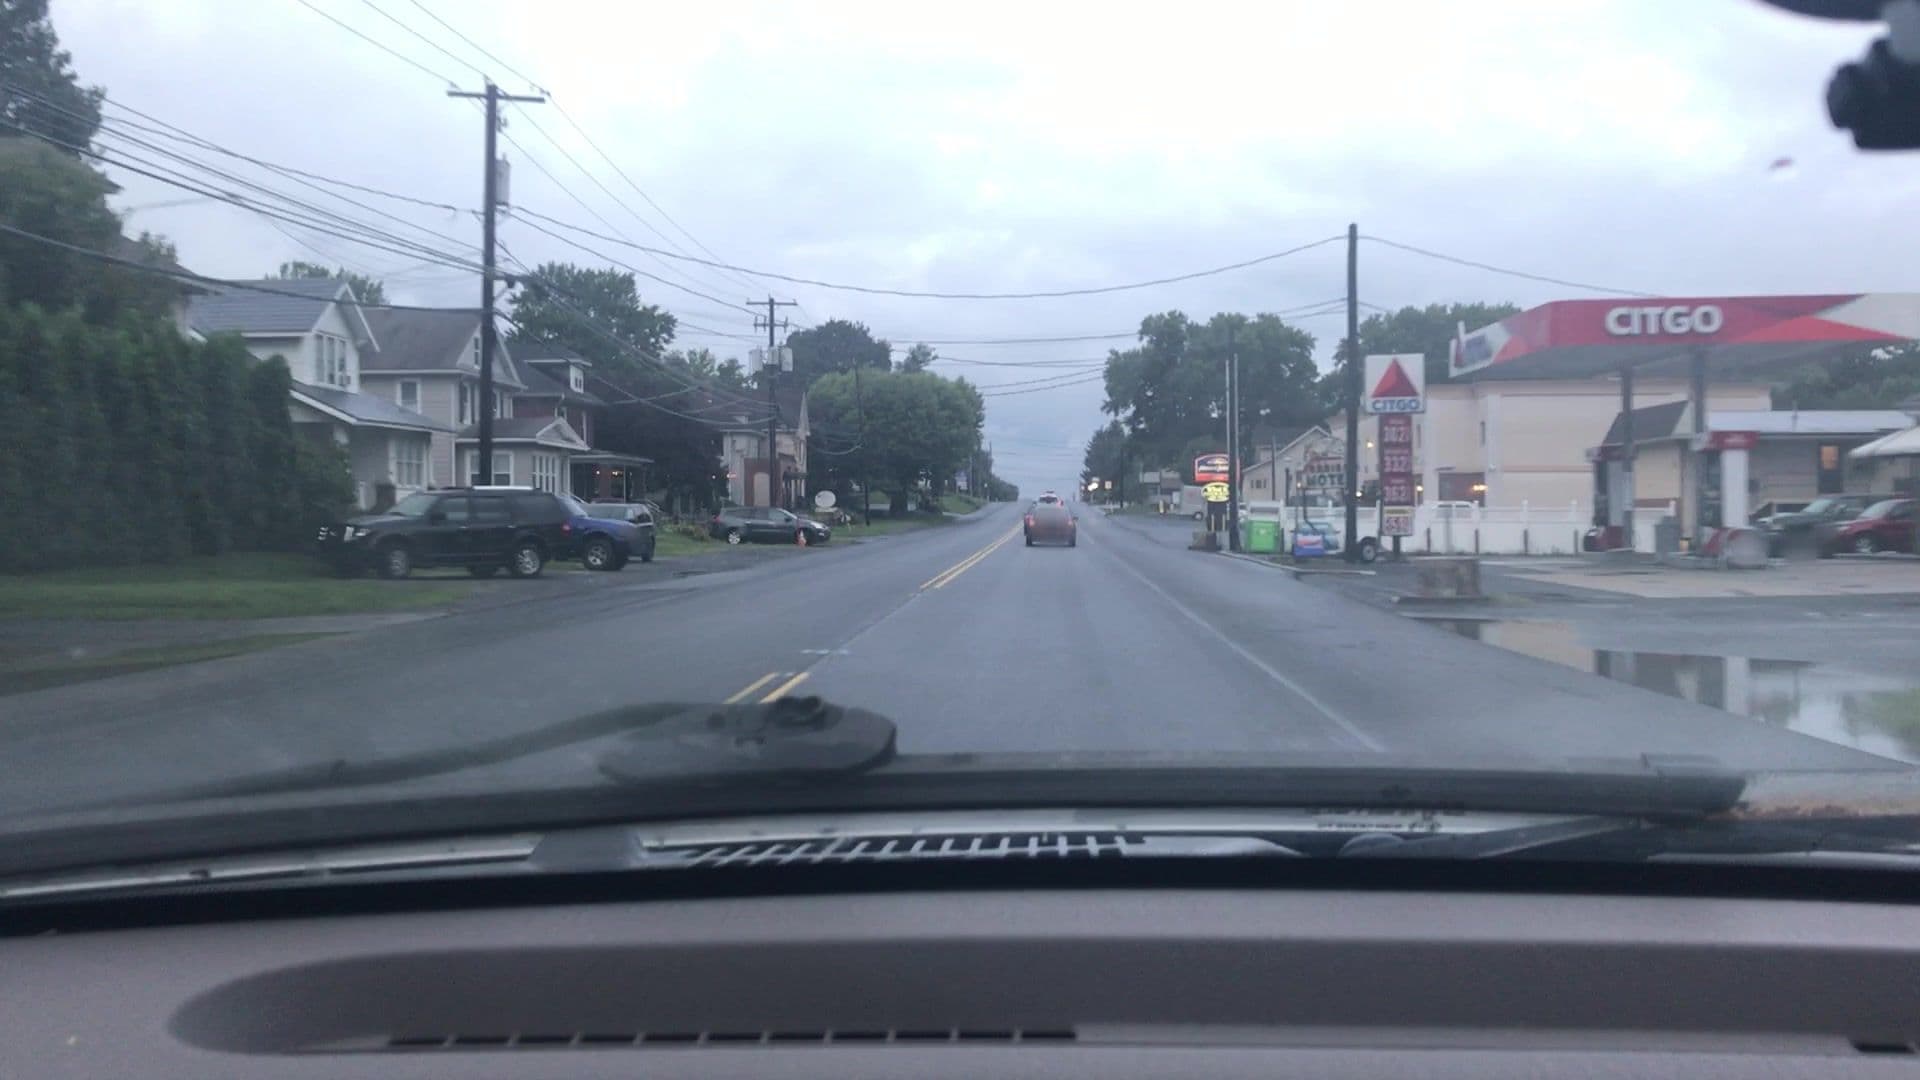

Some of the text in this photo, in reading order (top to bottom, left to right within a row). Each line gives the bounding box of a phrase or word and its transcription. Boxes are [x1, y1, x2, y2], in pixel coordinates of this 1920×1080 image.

[1604, 304, 1723, 335] CITGO
[1371, 399, 1420, 412] CITGO
[1306, 472, 1347, 487] MOTE
